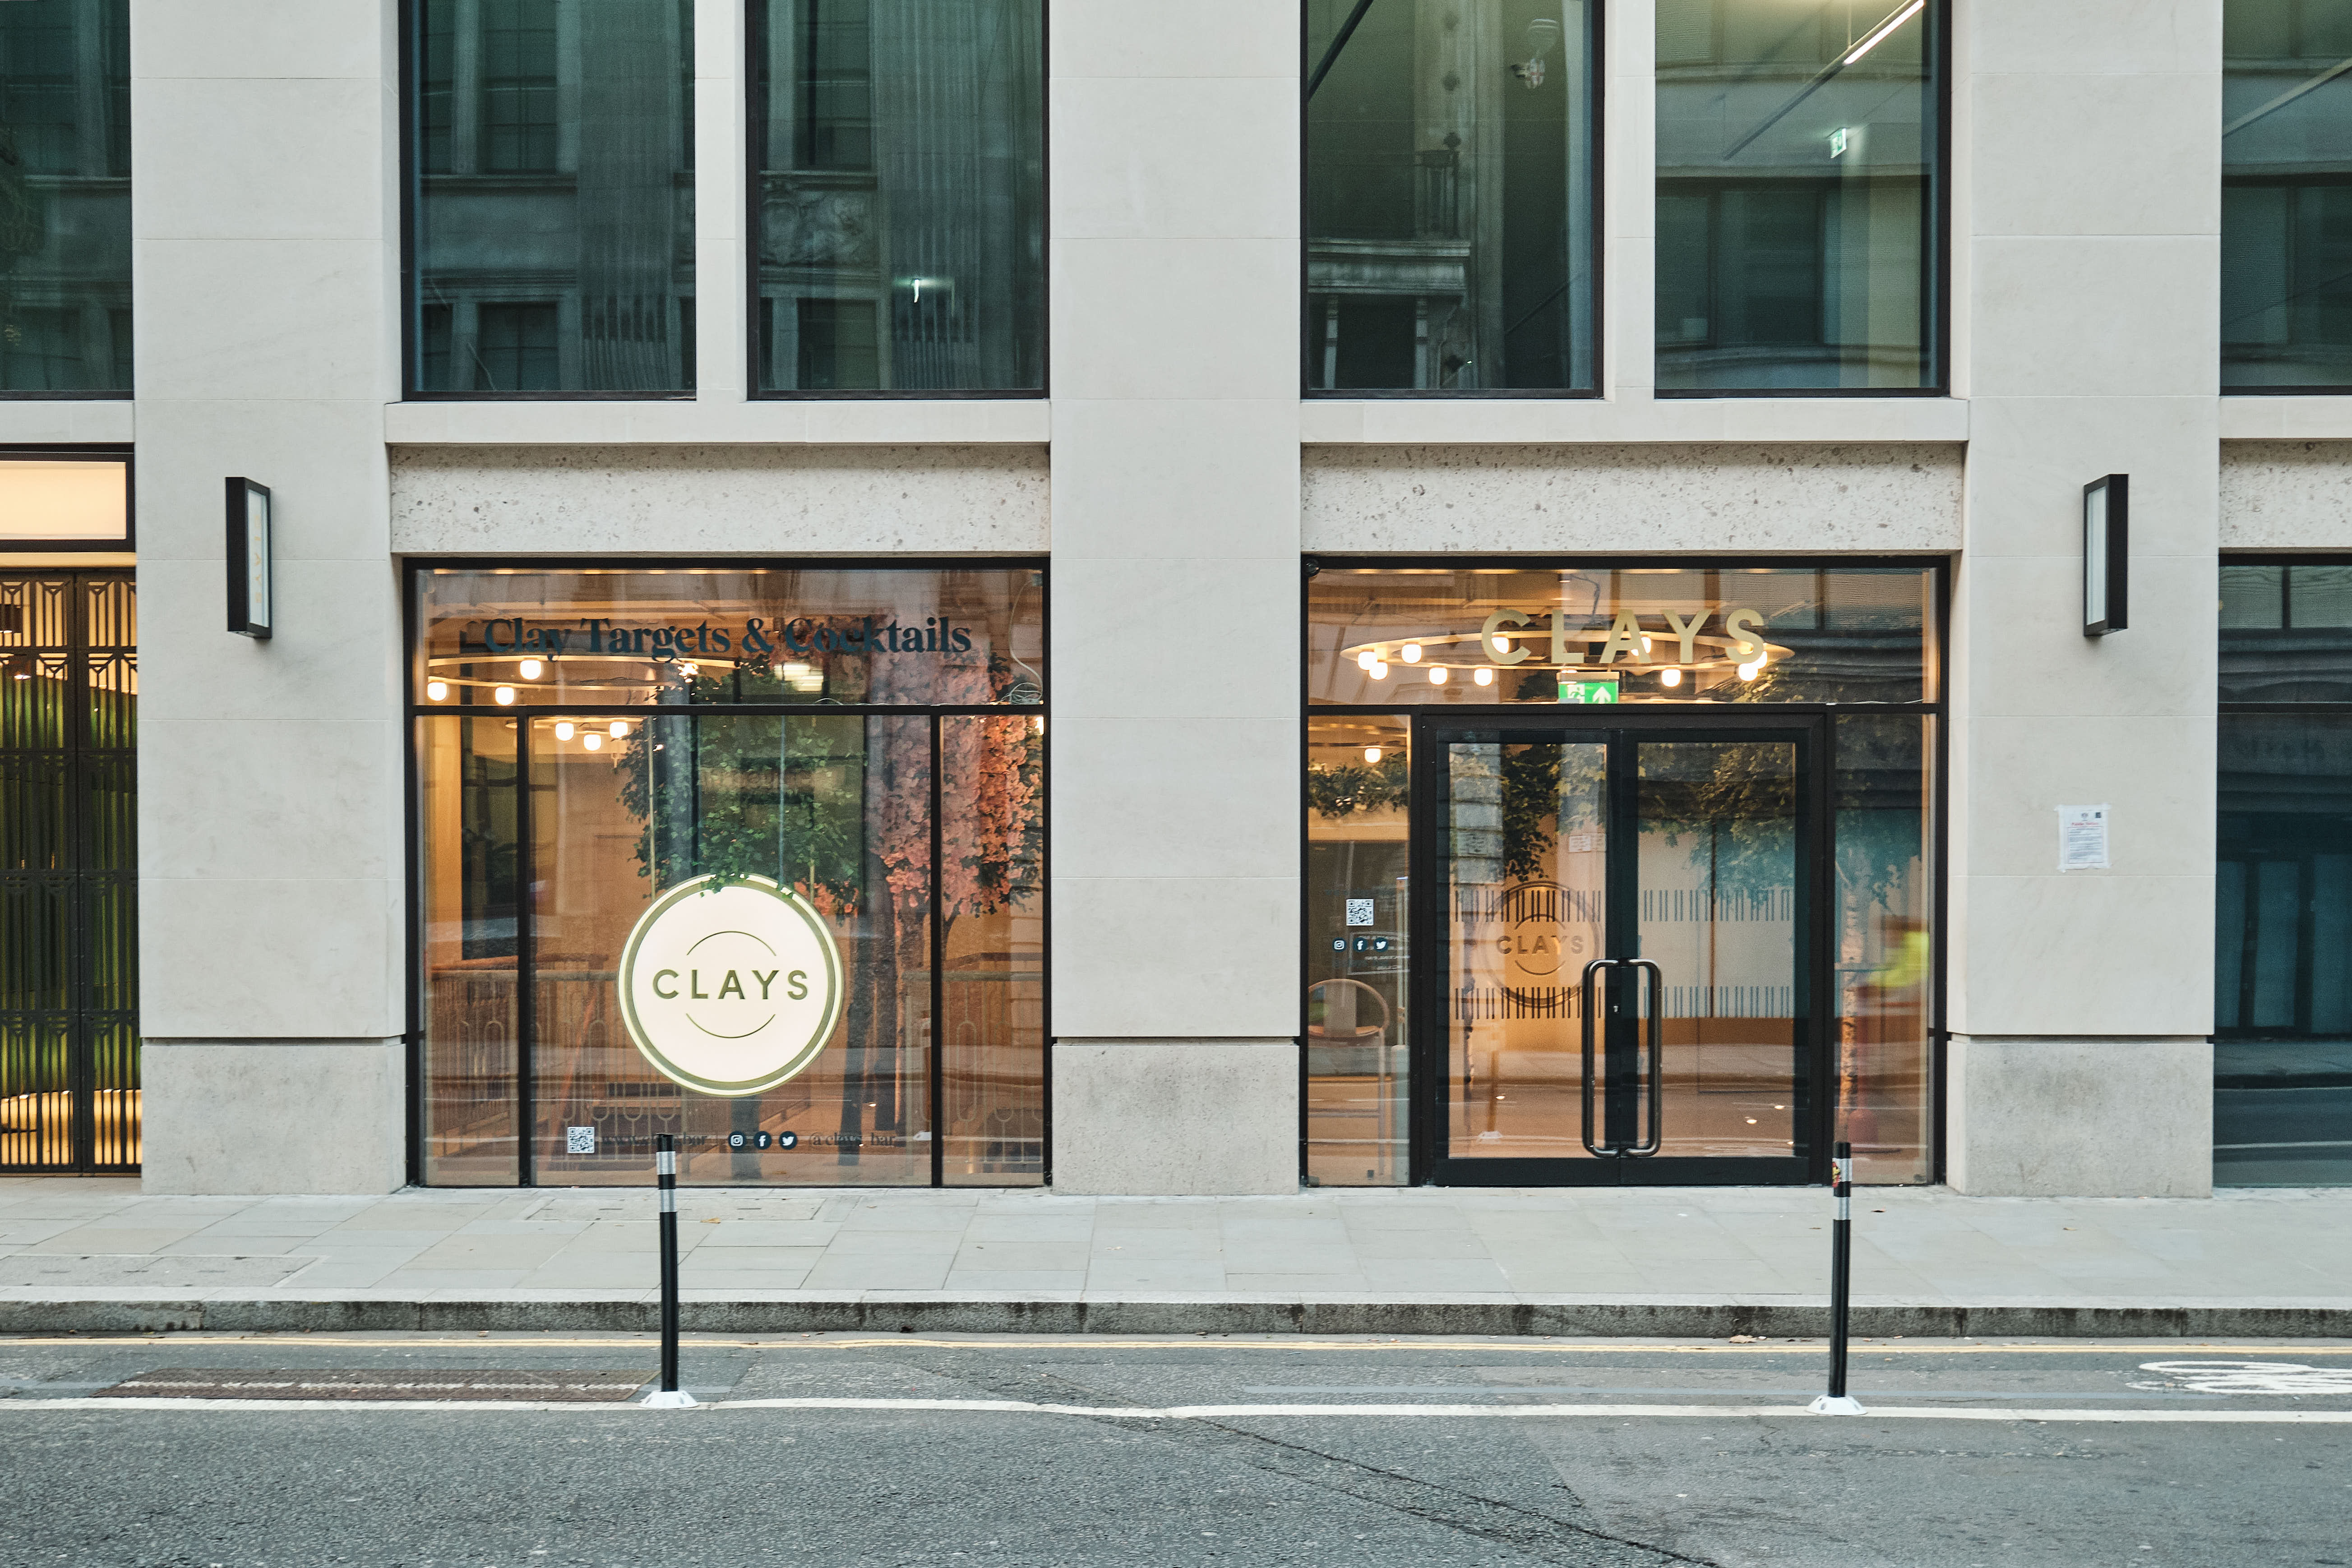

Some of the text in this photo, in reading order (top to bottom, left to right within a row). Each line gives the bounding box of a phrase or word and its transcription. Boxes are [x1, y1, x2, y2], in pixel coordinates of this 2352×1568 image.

[484, 615, 972, 664] Clay Targets & Cocktails
[1481, 608, 1765, 665] CLAYS
[1497, 935, 1584, 955] CLAYS
[652, 968, 809, 1001] CLAYS
